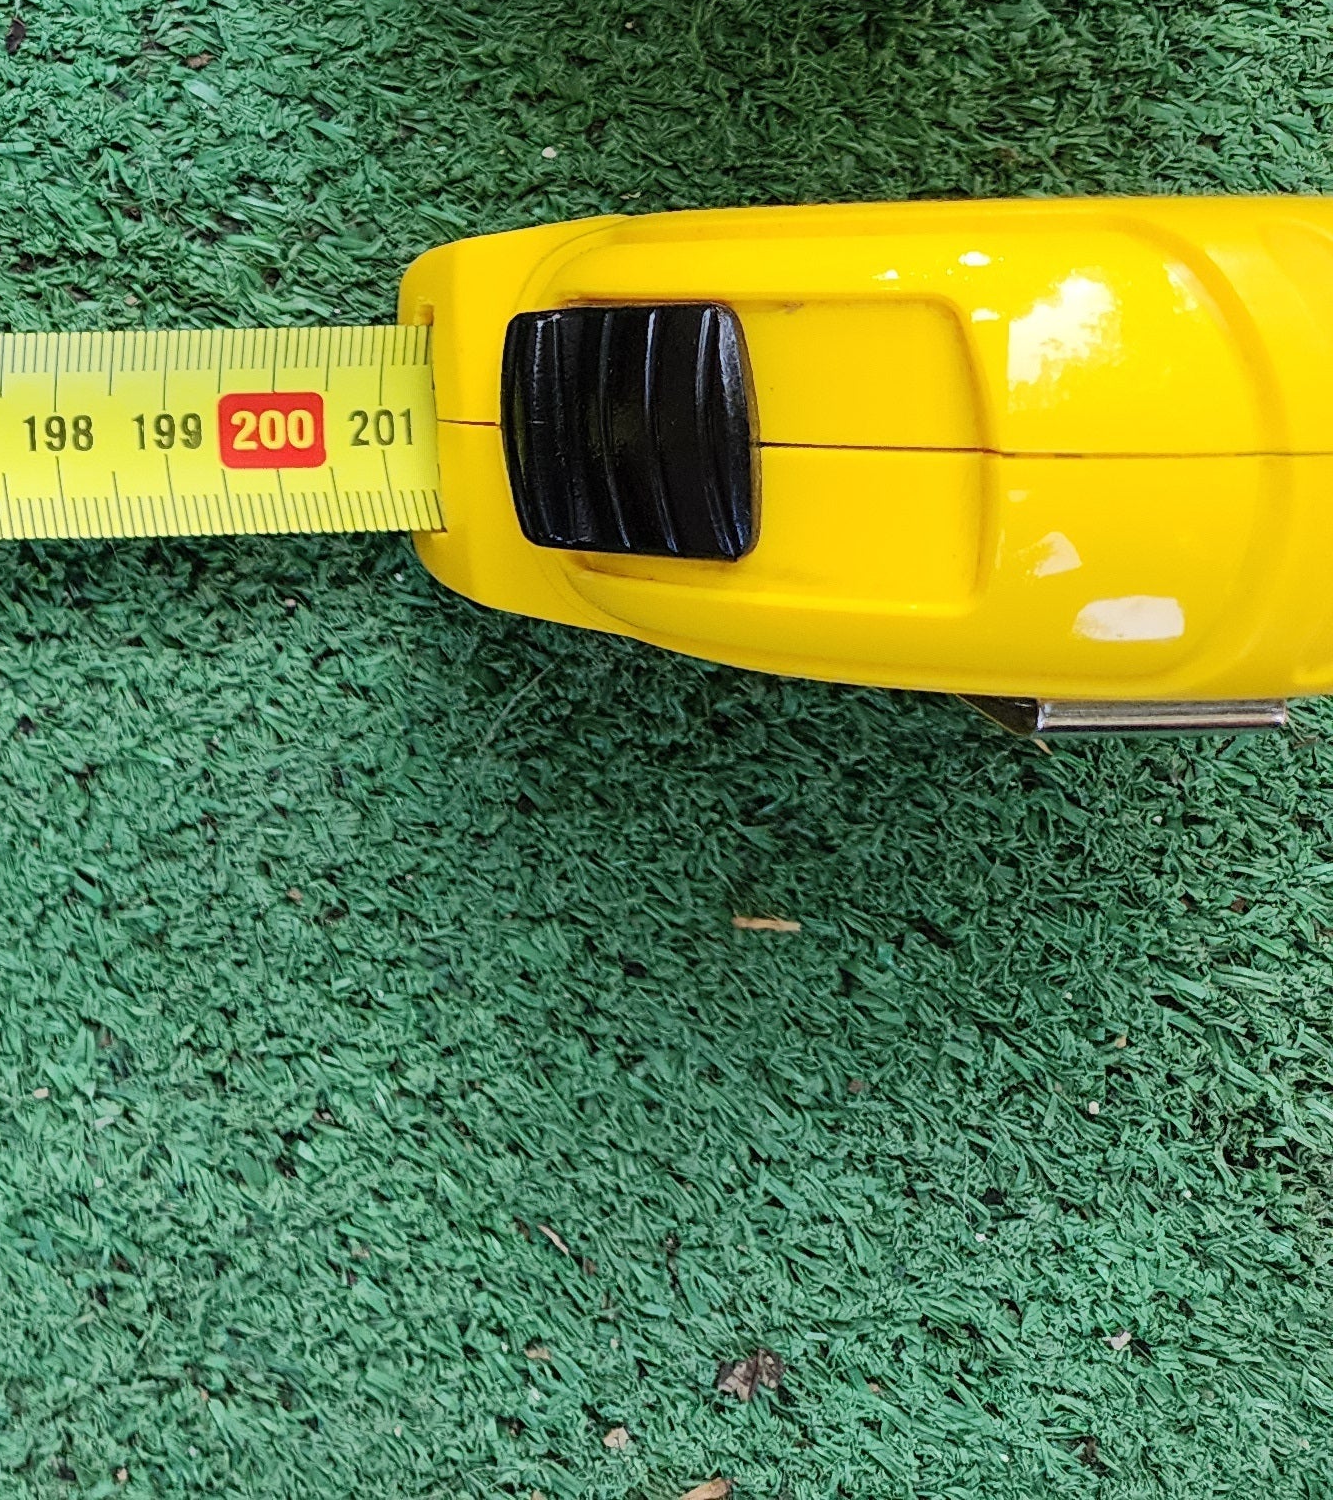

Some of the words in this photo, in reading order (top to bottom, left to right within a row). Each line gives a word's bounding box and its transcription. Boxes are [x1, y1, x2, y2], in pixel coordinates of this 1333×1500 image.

[23, 415, 93, 451] 198
[133, 413, 202, 449] 199
[232, 411, 315, 450] 200
[349, 408, 413, 446] 201
